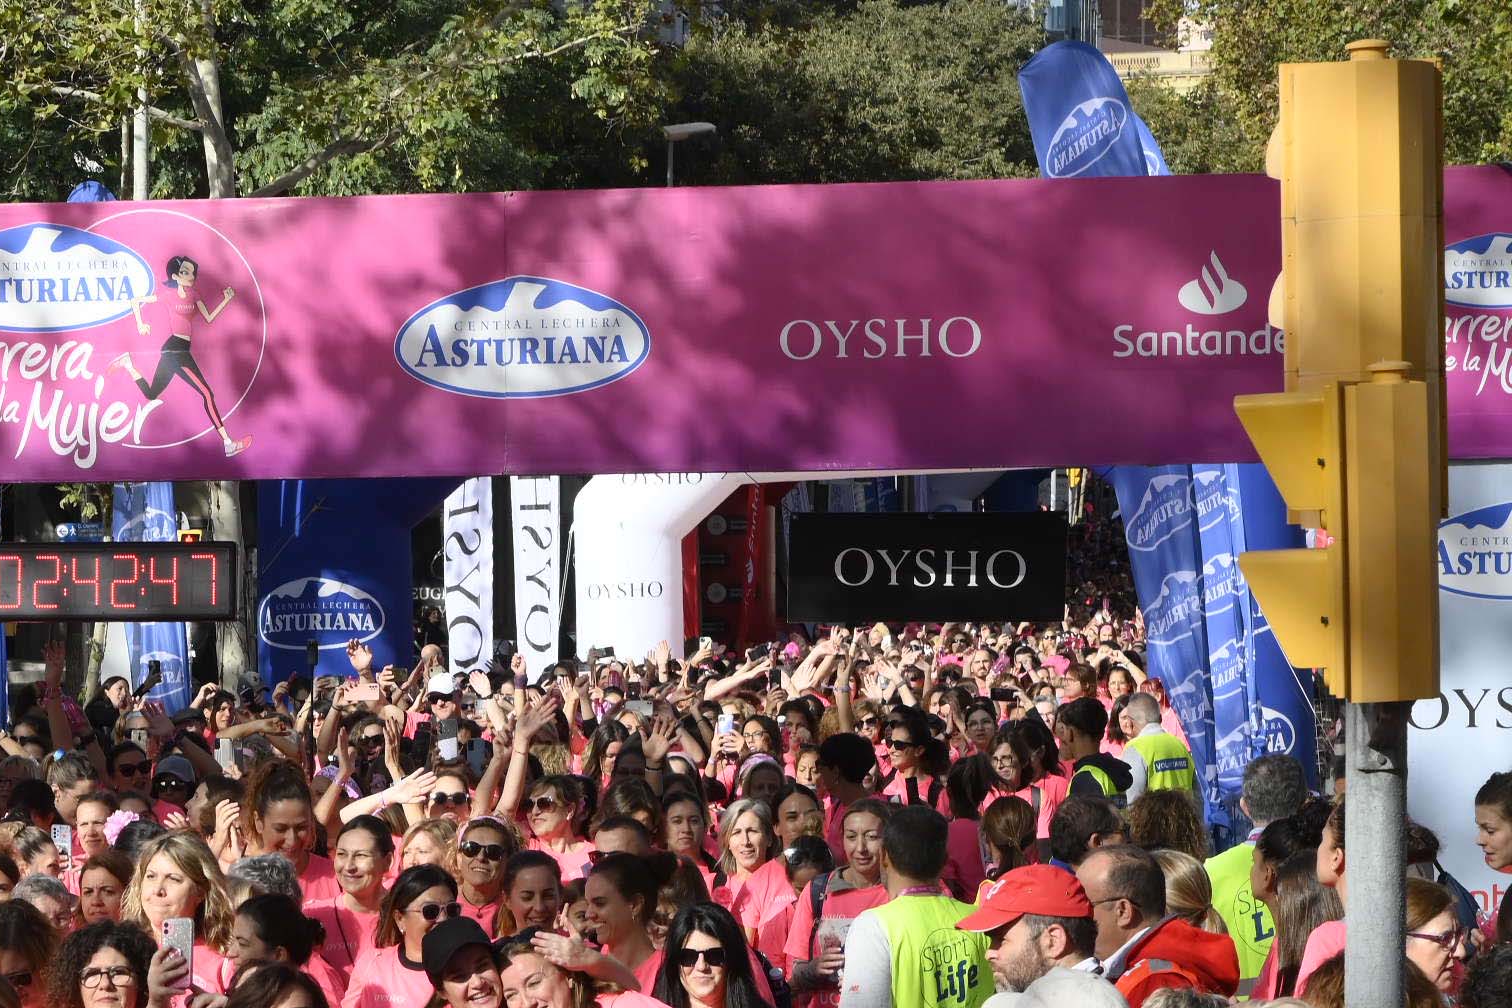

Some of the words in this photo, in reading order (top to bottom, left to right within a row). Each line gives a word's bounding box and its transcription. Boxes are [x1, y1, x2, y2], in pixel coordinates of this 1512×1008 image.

[454, 319, 533, 331] CENTRAL
[541, 316, 622, 329] LECHERA
[779, 316, 982, 360] OYSHO
[1112, 324, 1287, 357] Santande
[414, 327, 630, 368] ASTURIANA
[1463, 343, 1481, 372] la
[14, 375, 164, 469] Mujer
[1460, 537, 1510, 547] CENTR
[834, 547, 1027, 588] OYSHO
[322, 600, 372, 610] LECHERA
[587, 581, 664, 600] OYSHO
[263, 606, 376, 635] ASTURIANA
[1407, 687, 1512, 730] OYS
[923, 935, 972, 973] Sport
[934, 959, 979, 1004] Life
